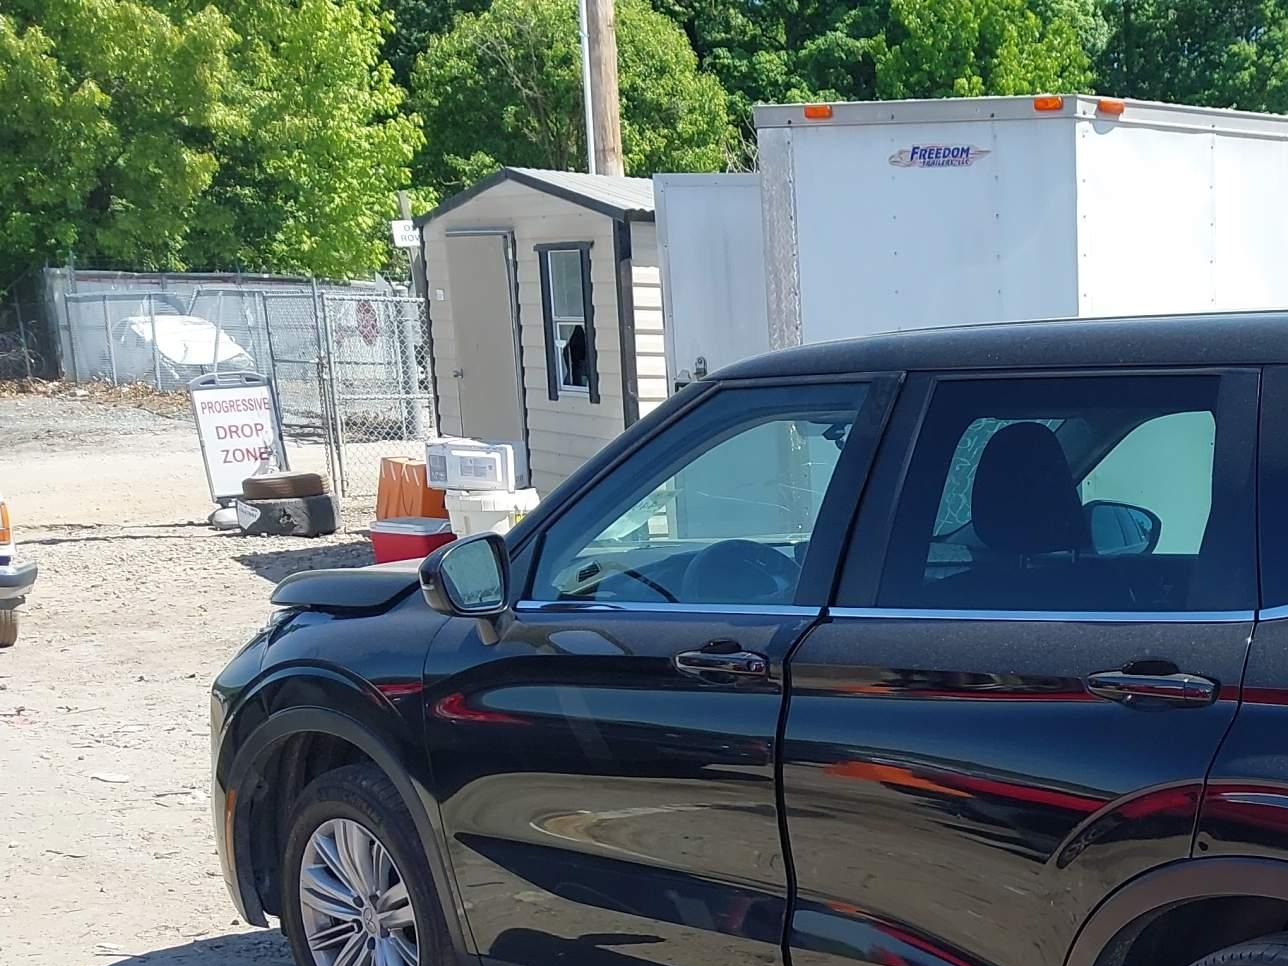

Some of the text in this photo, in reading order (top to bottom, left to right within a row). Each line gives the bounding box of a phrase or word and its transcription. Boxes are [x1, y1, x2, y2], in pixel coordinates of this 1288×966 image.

[910, 146, 970, 162] FREEDOM
[200, 397, 271, 414] PROGRESSIVE
[215, 423, 264, 440] DROP
[221, 446, 270, 463] ZONE
